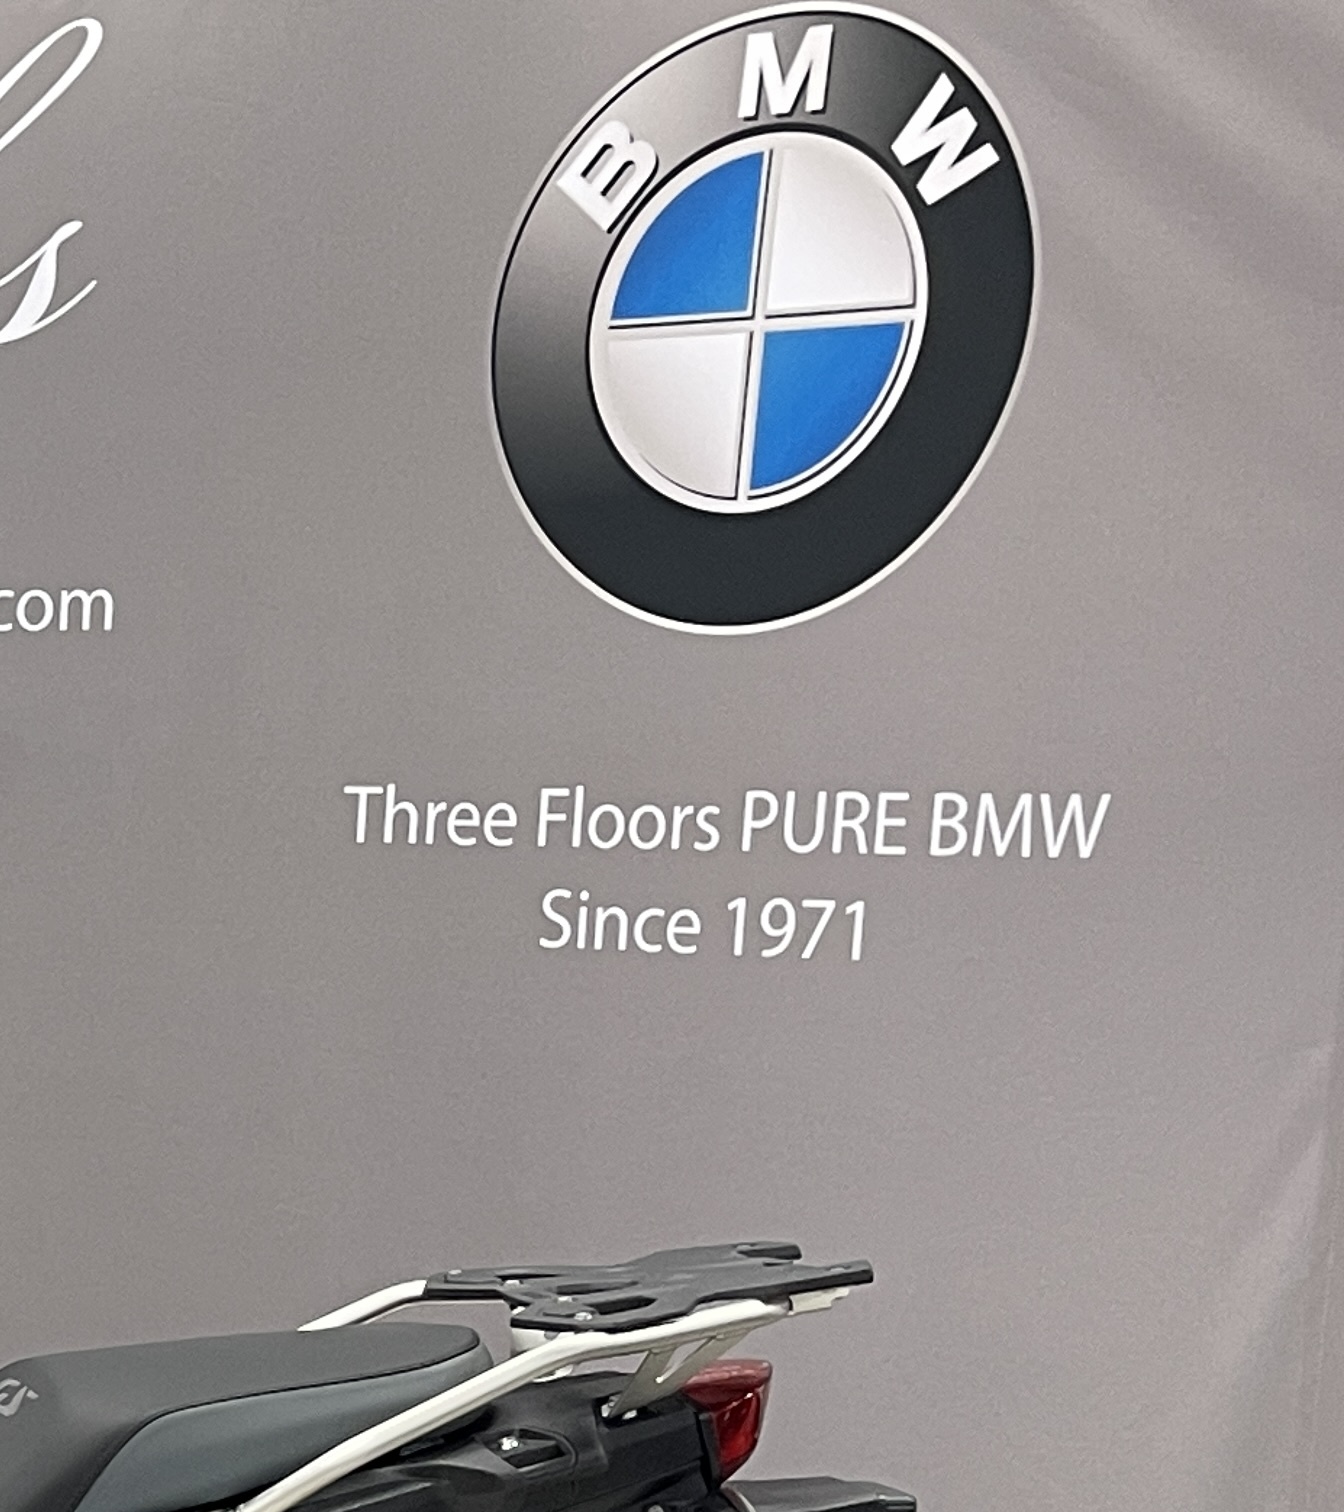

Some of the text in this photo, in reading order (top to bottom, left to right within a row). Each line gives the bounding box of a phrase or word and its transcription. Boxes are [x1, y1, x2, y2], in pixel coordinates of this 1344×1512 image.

[555, 24, 1000, 232] BMW
[342, 783, 1112, 859] Three Floors PURE BMW
[538, 888, 866, 961] Since 1971
